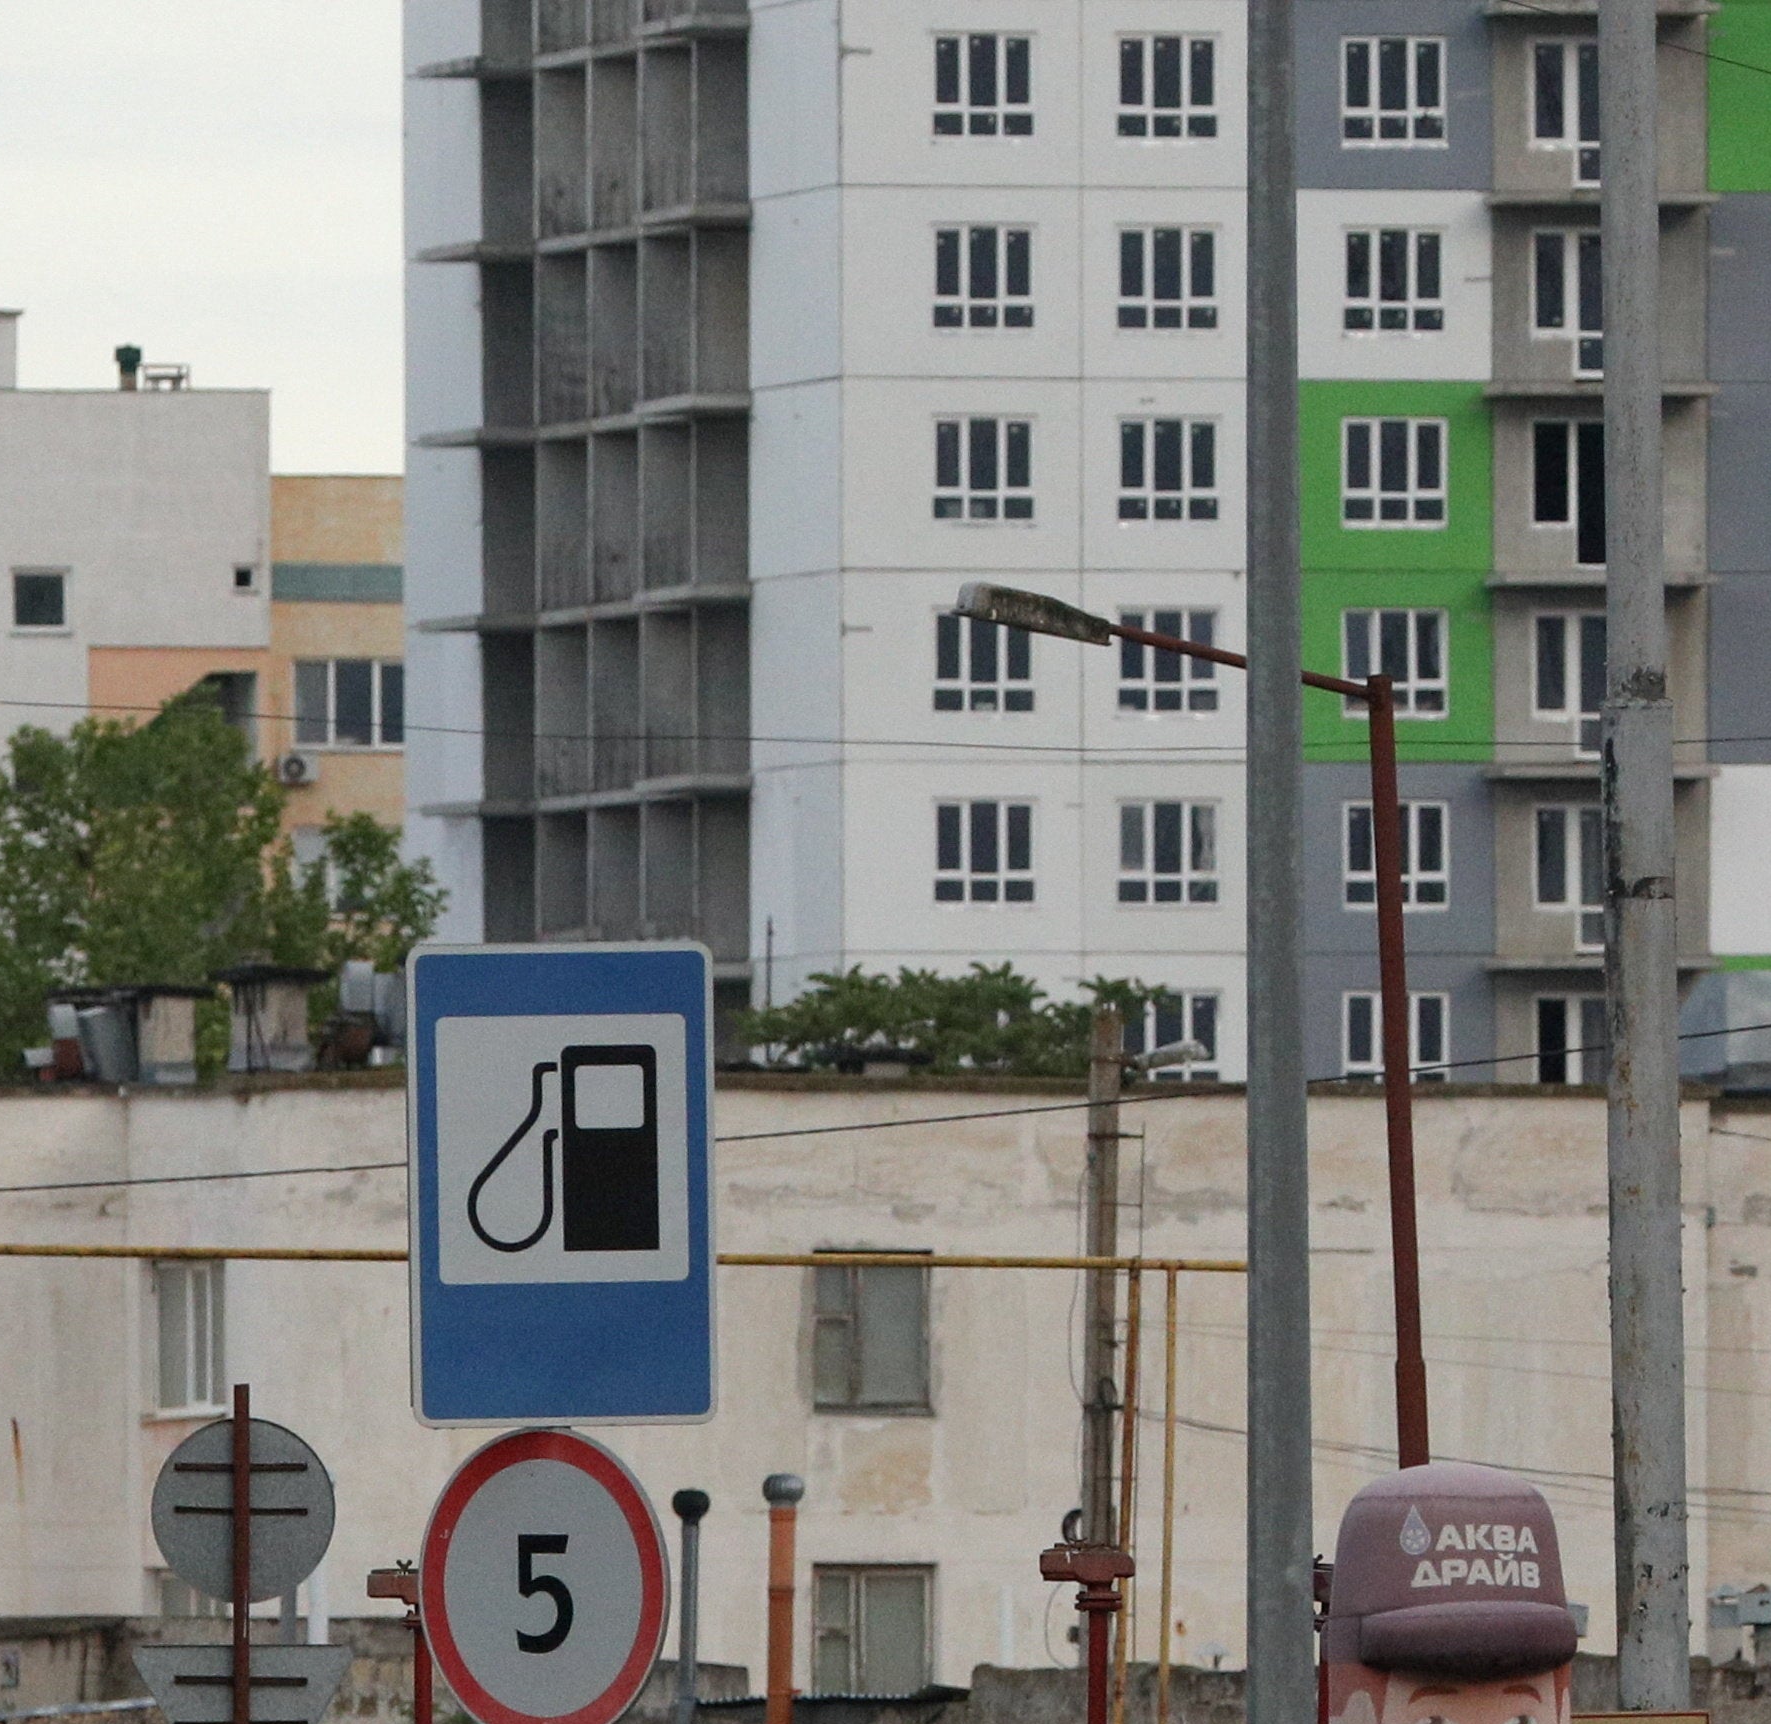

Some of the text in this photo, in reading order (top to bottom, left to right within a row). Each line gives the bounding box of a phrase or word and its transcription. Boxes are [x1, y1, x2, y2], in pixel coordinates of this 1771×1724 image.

[1435, 1523, 1539, 1555] АКВА
[1410, 1552, 1541, 1589] ДРАЙВ
[516, 1533, 575, 1655] 5
